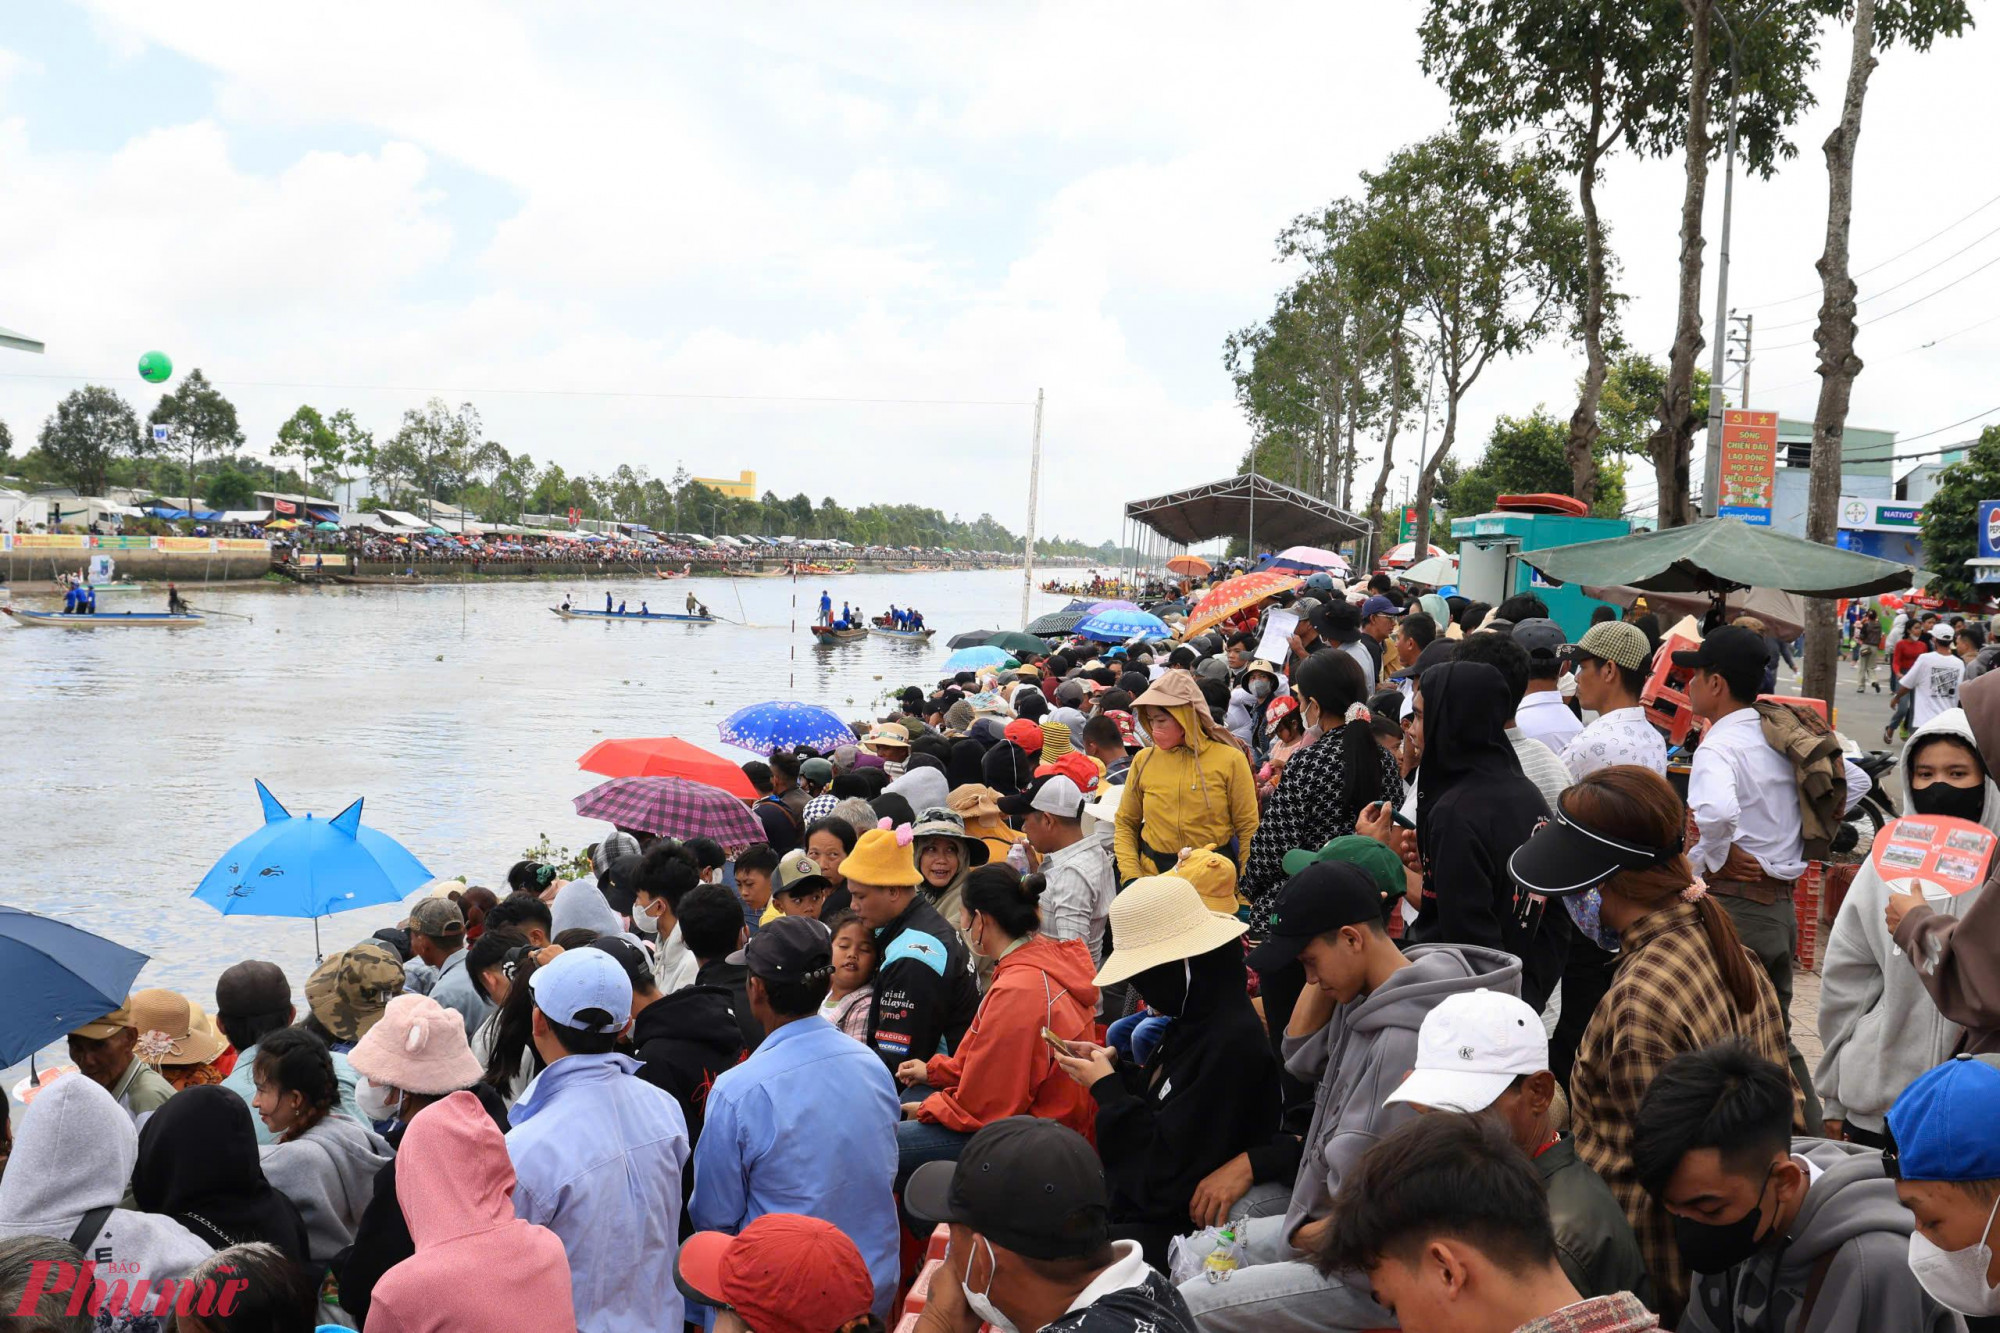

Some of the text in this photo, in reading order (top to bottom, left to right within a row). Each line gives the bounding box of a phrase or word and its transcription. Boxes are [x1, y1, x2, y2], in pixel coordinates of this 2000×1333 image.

[1727, 452, 1743, 461] LAO
[1883, 511, 1913, 519] NATIVO
[884, 990, 906, 999] visit
